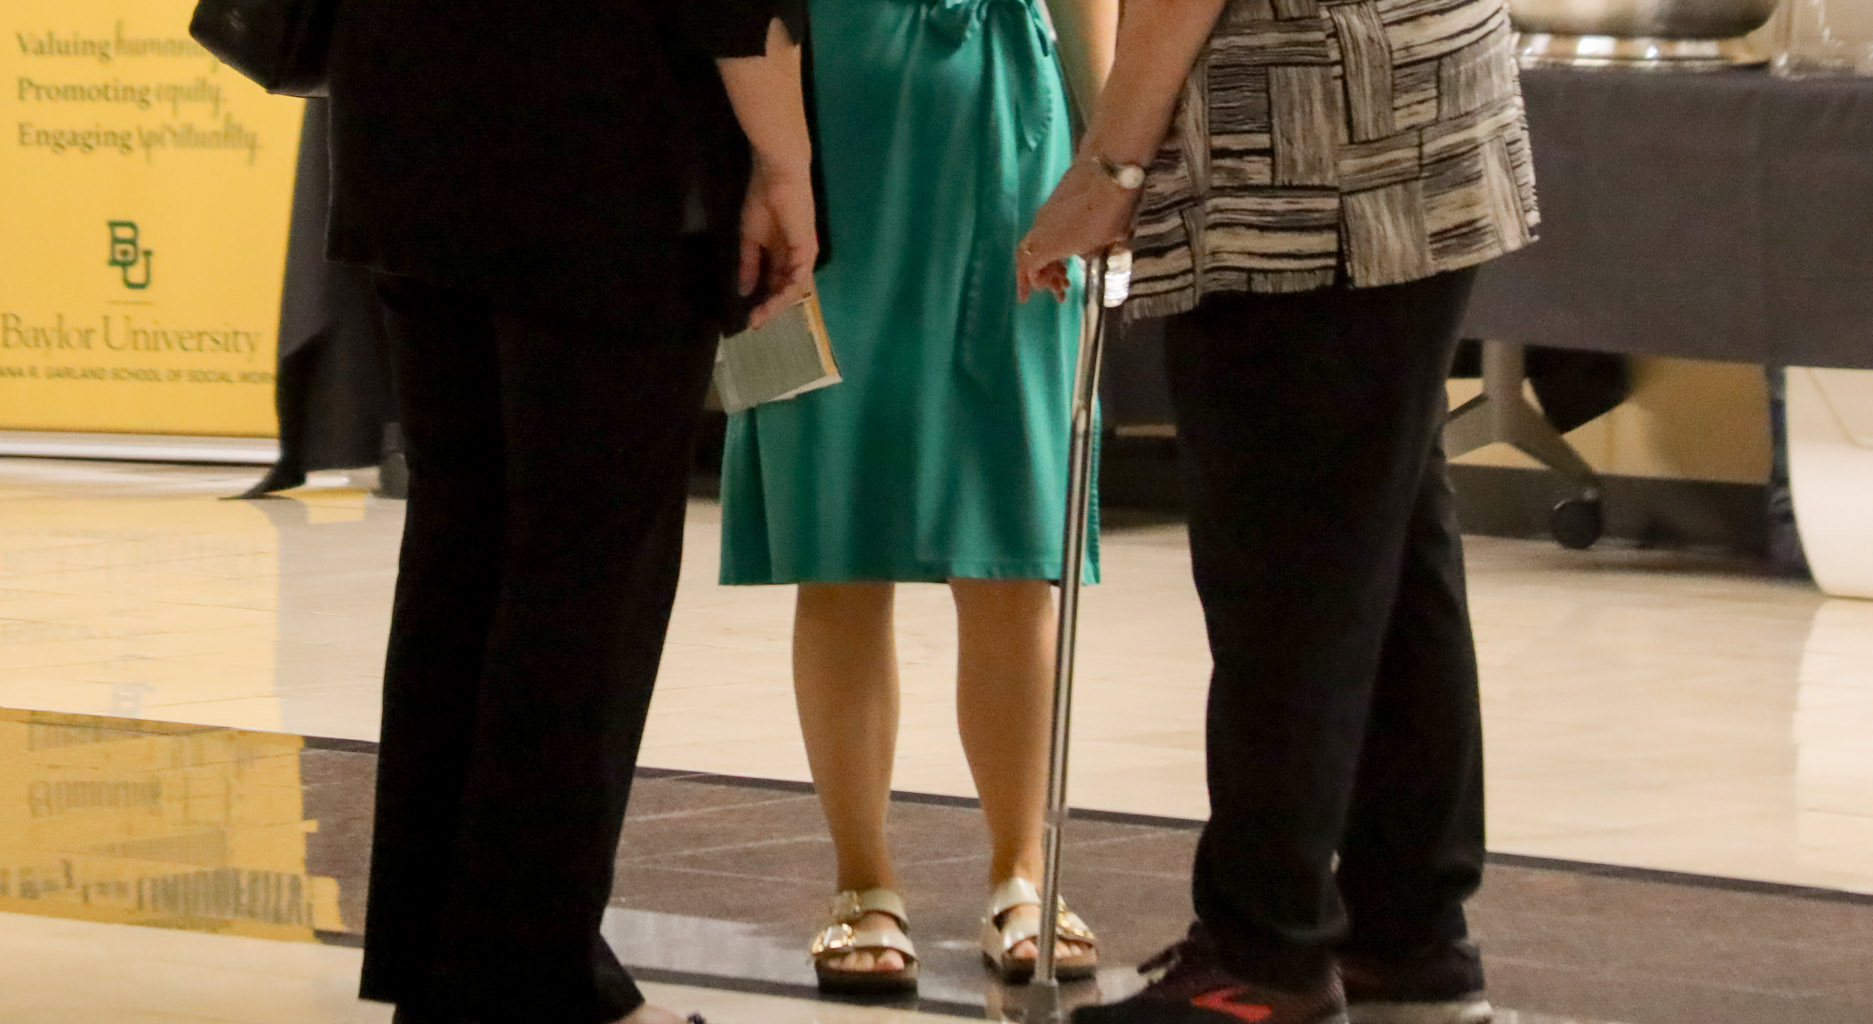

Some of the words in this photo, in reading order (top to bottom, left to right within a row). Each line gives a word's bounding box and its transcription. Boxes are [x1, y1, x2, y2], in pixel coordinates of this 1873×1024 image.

[16, 31, 112, 65] Valuing
[18, 76, 151, 111] Promoting
[18, 122, 134, 155] Engaging
[107, 220, 154, 290] BU
[0, 313, 97, 358] Baylor
[102, 315, 262, 363] University
